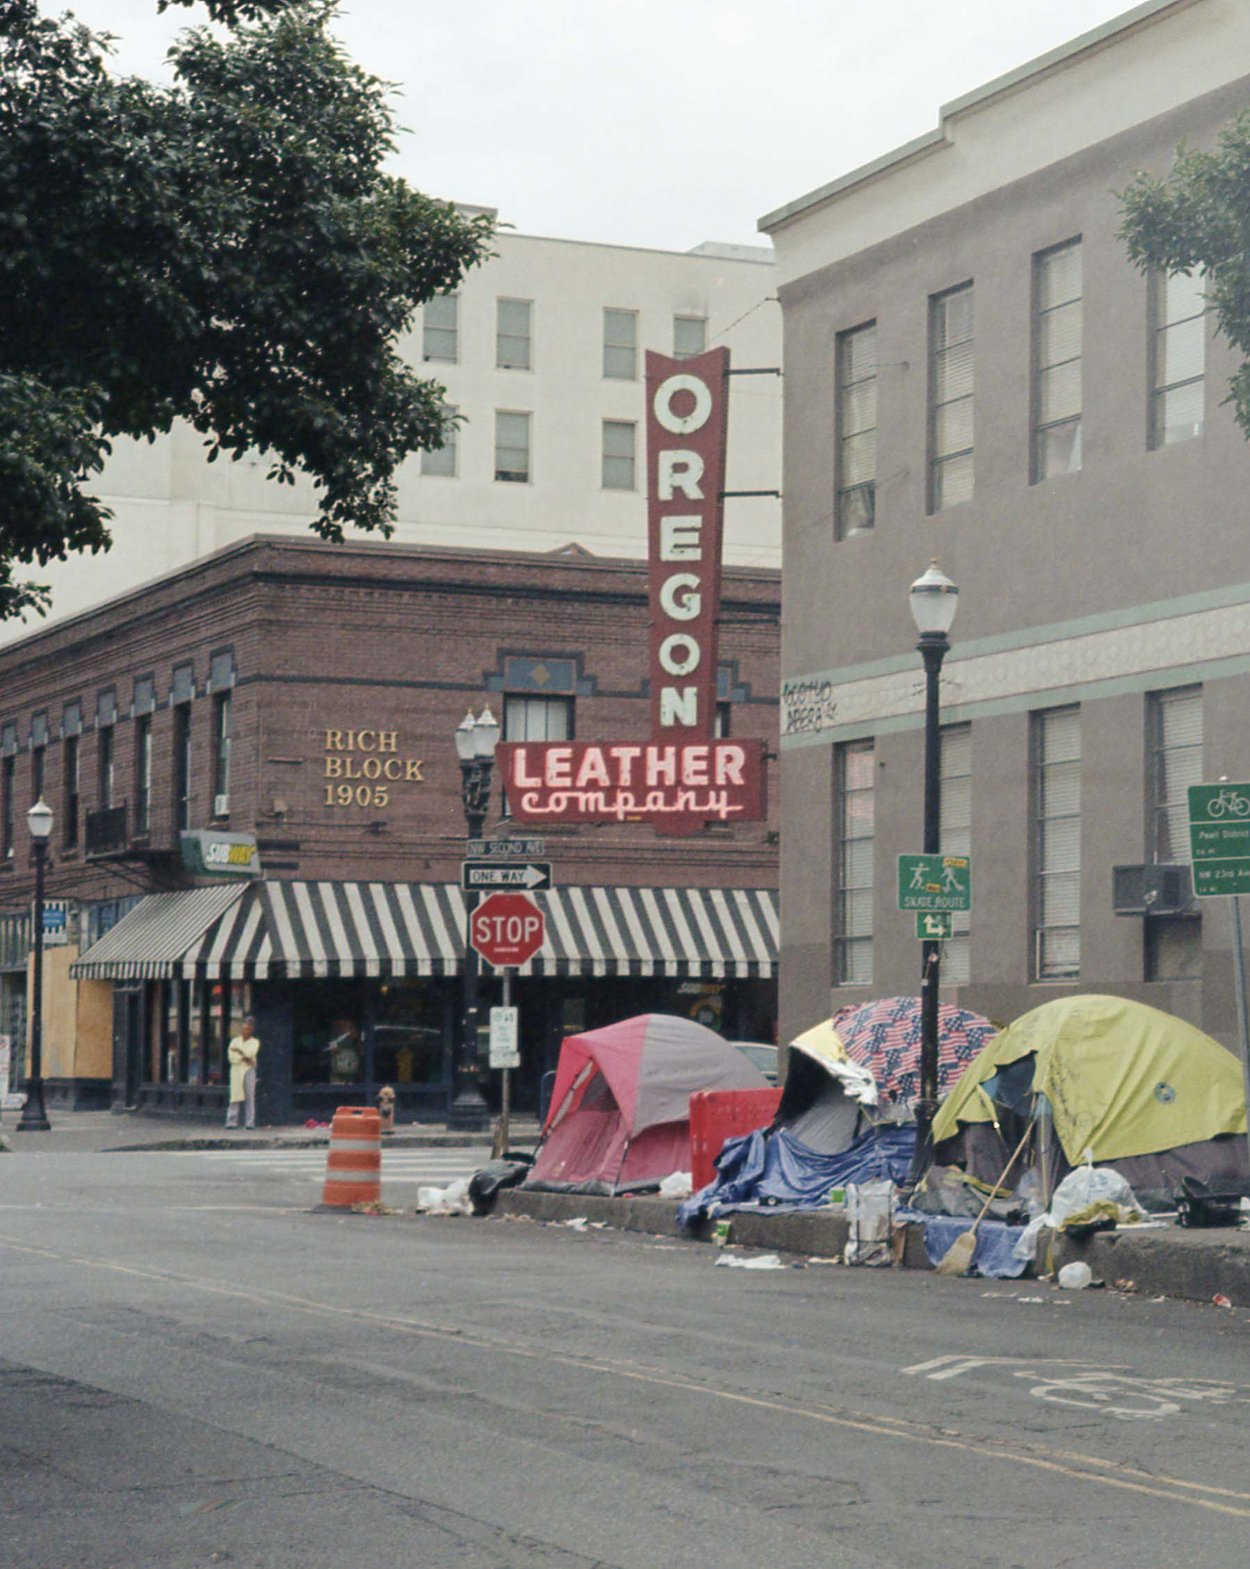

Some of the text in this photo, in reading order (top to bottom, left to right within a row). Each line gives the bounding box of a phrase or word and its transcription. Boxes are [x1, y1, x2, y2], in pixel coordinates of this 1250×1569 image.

[653, 373, 713, 727] OREGON
[324, 729, 398, 753] RICH
[324, 757, 424, 780] BLOCK
[513, 745, 746, 788] LEATHER
[324, 784, 389, 807] 1905
[521, 788, 744, 820] company
[206, 843, 257, 865] SUBWAY
[472, 871, 525, 881] ONE WAY
[904, 896, 965, 909] SKATE ROUTE
[476, 916, 539, 943] STOP
